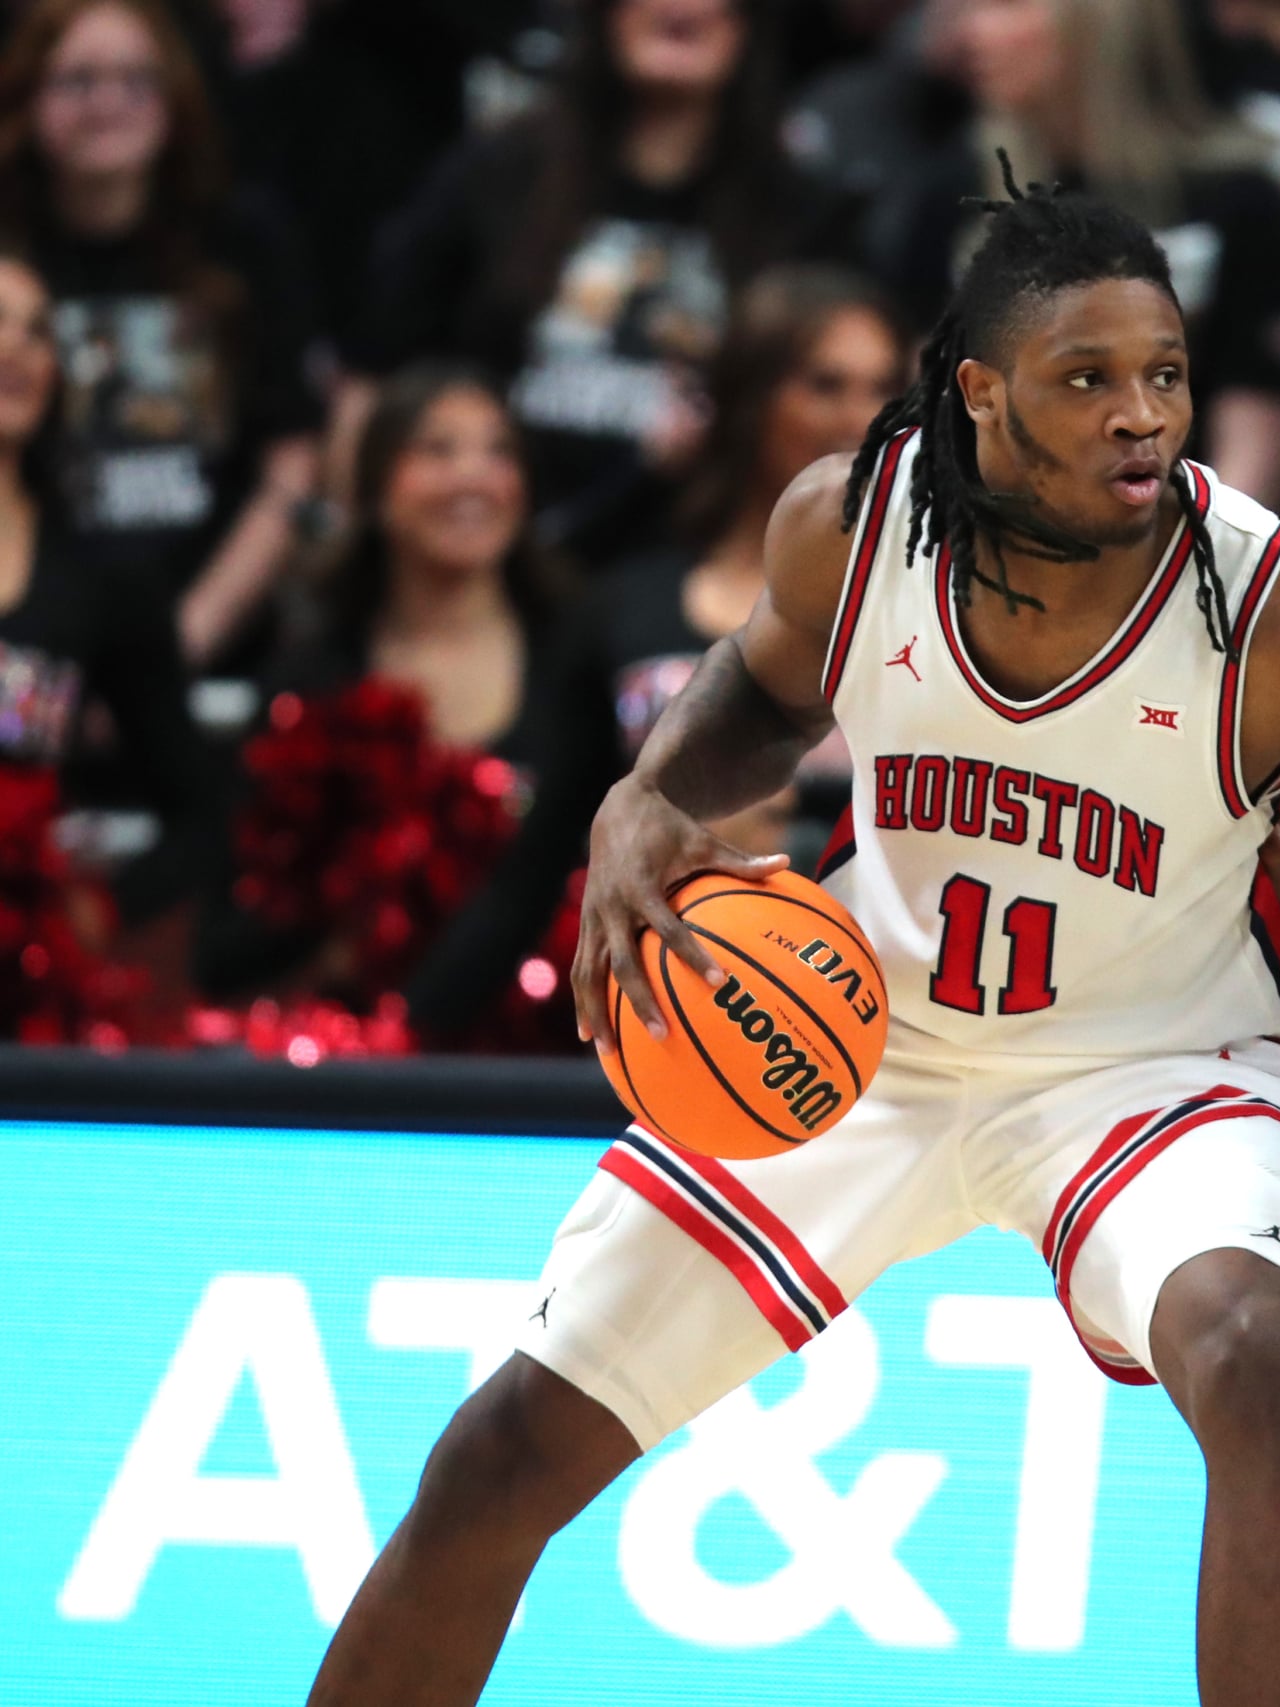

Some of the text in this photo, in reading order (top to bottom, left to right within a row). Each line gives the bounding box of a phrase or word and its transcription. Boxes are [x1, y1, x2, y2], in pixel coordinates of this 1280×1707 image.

[1140, 705, 1178, 730] XII
[874, 753, 1166, 898] HOUSTON
[761, 930, 879, 1026] EVO NXT
[929, 872, 1057, 1016] 11
[713, 974, 842, 1132] Wilson
